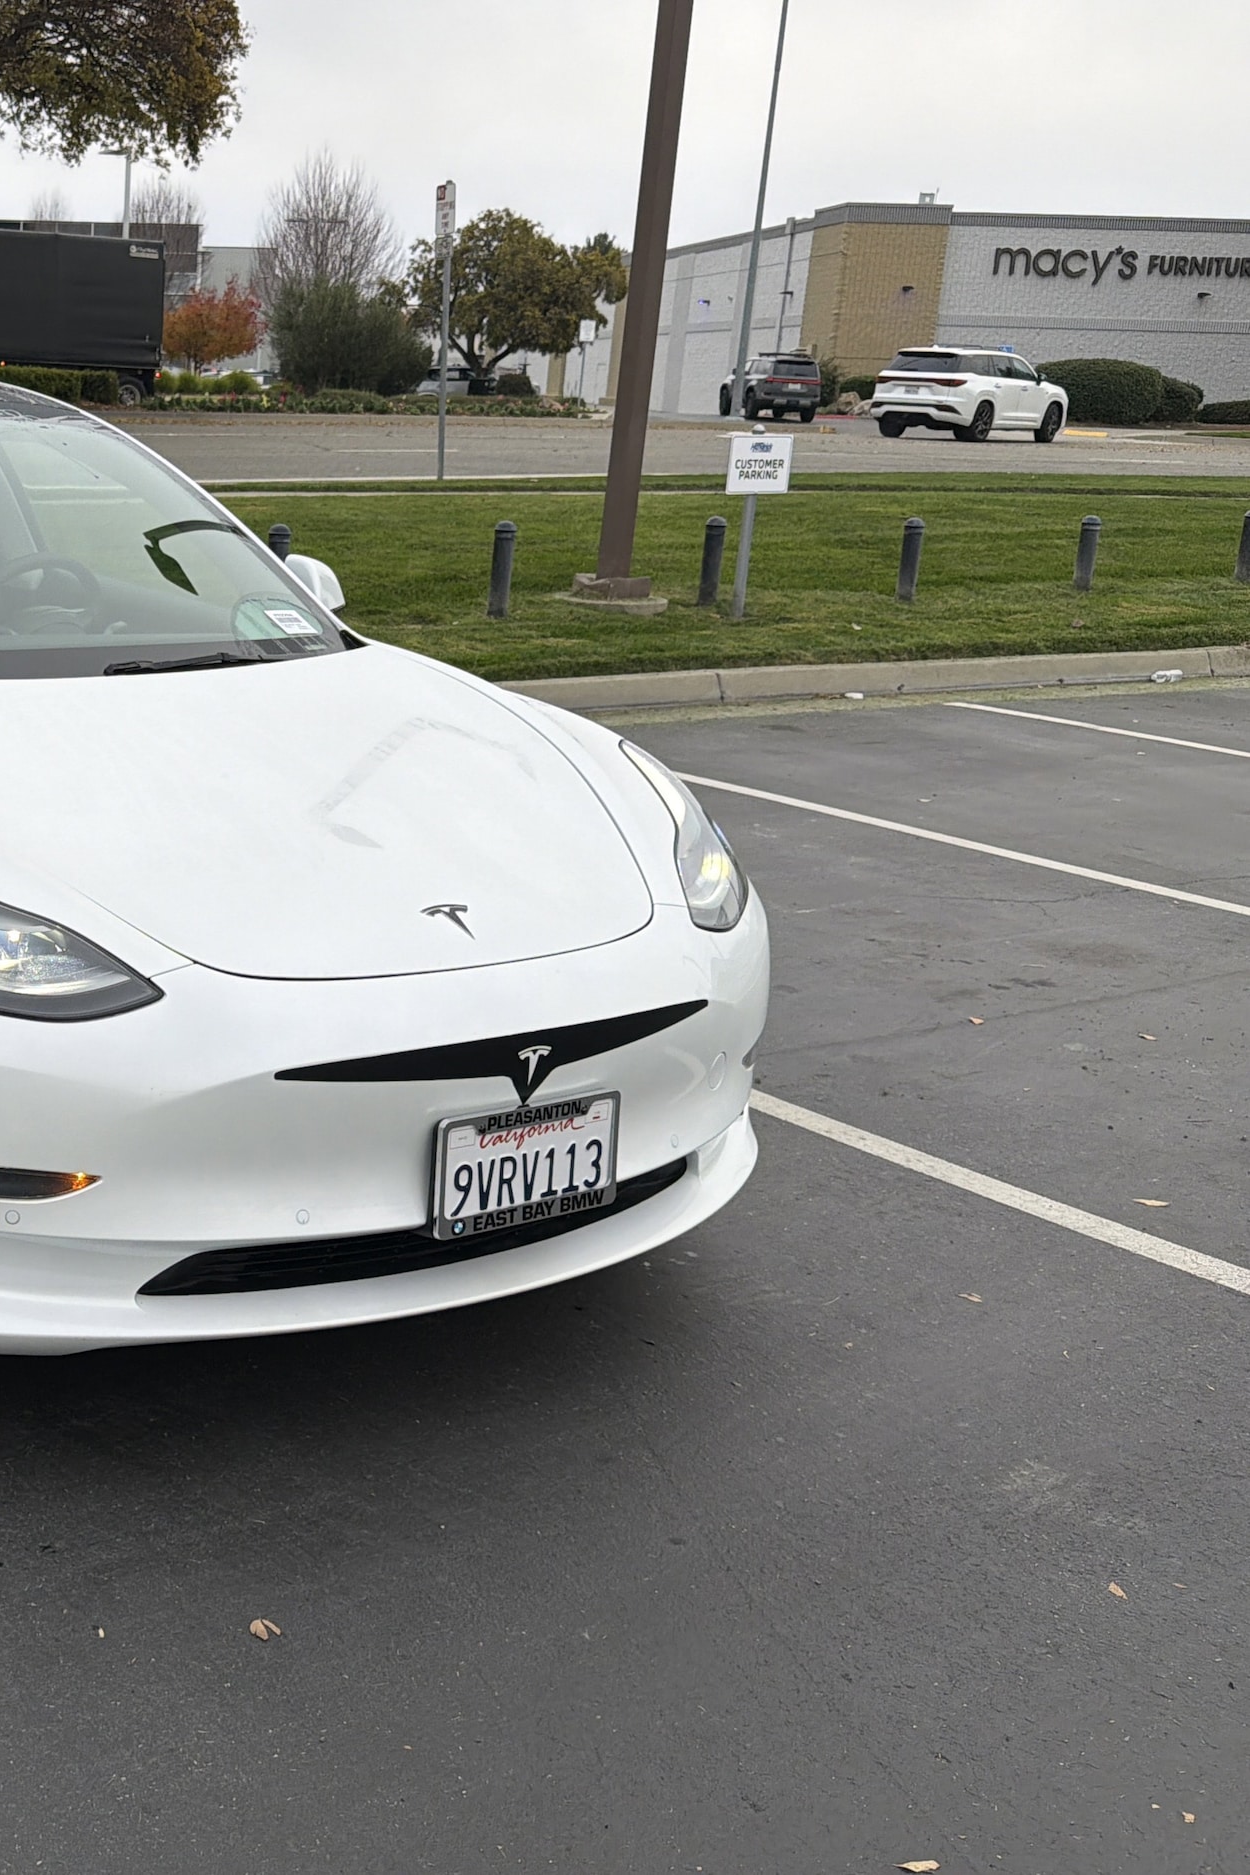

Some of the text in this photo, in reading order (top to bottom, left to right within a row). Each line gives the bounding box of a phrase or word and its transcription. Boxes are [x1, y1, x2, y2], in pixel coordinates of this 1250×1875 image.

[992, 245, 1138, 286] macy's
[735, 459, 784, 470] CUSTOMER
[738, 470, 778, 480] PARKING
[487, 1100, 581, 1131] PLEASANTON
[479, 1117, 585, 1149] California
[450, 1139, 603, 1218] 9VRV113
[473, 1190, 605, 1232] EAST BAY BMW
